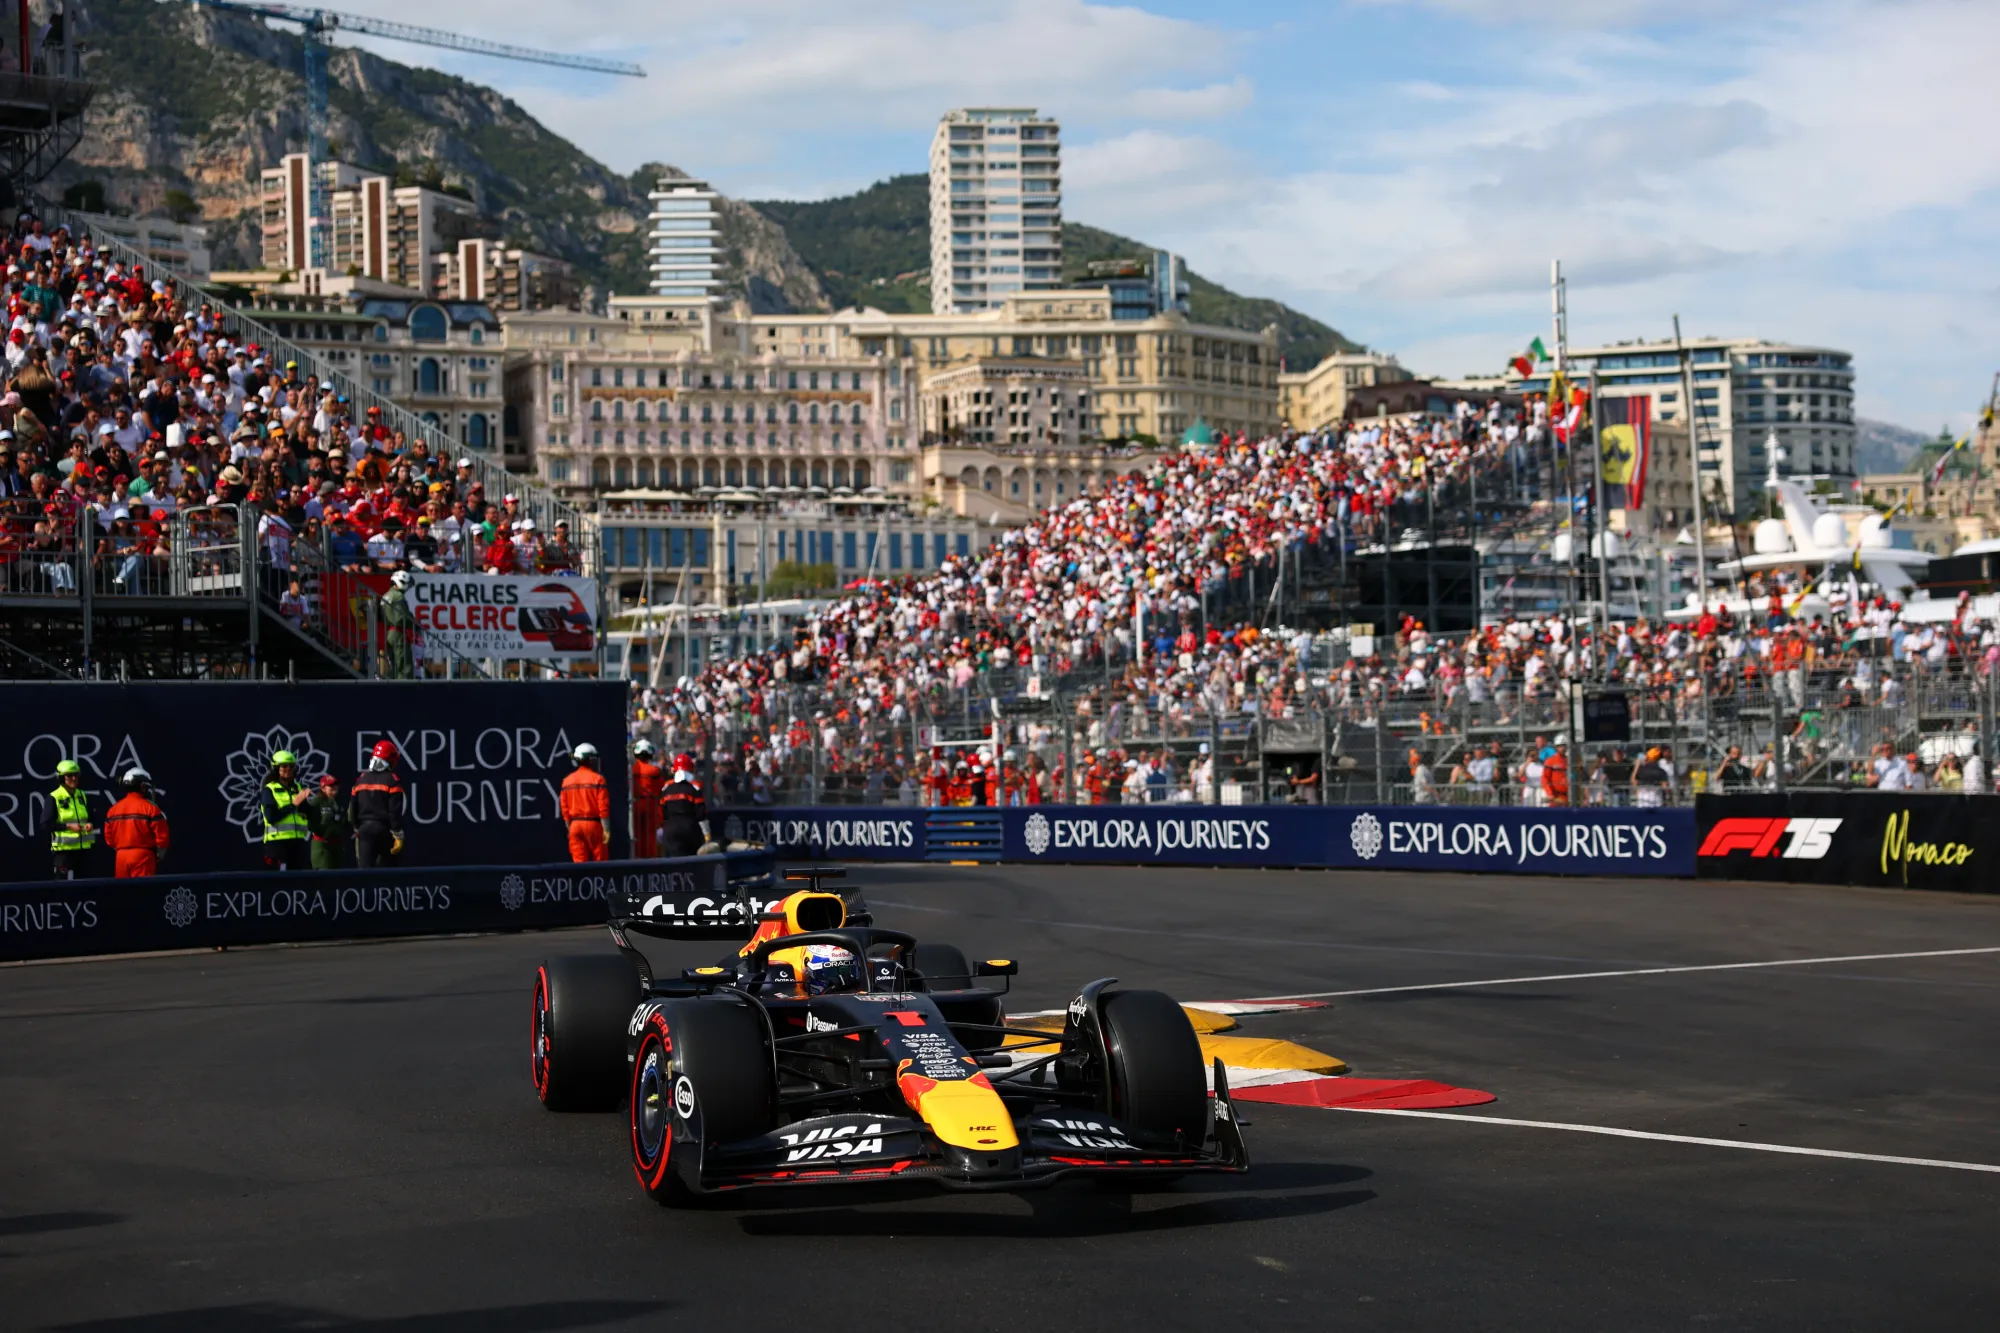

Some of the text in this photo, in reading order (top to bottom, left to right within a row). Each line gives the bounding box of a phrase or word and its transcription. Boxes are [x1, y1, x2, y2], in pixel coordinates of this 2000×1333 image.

[415, 582, 519, 604] CHARLES
[414, 604, 517, 631] ECLERC
[454, 632, 509, 641] OFFICIAL
[746, 819, 914, 851] EXPLORA JOURNEYS
[1054, 819, 1270, 855] EXPLORA JOURNEYS
[1389, 821, 1667, 865] EXPLORA JOURNEYS
[1881, 809, 1974, 885] Monaco
[206, 885, 450, 921] EXPLORA JOURNEYS
[531, 876, 618, 904] EXPLORA
[678, 1085, 692, 1107] Esso
[779, 1122, 883, 1162] VISA
[1041, 1117, 1144, 1151] VISA
